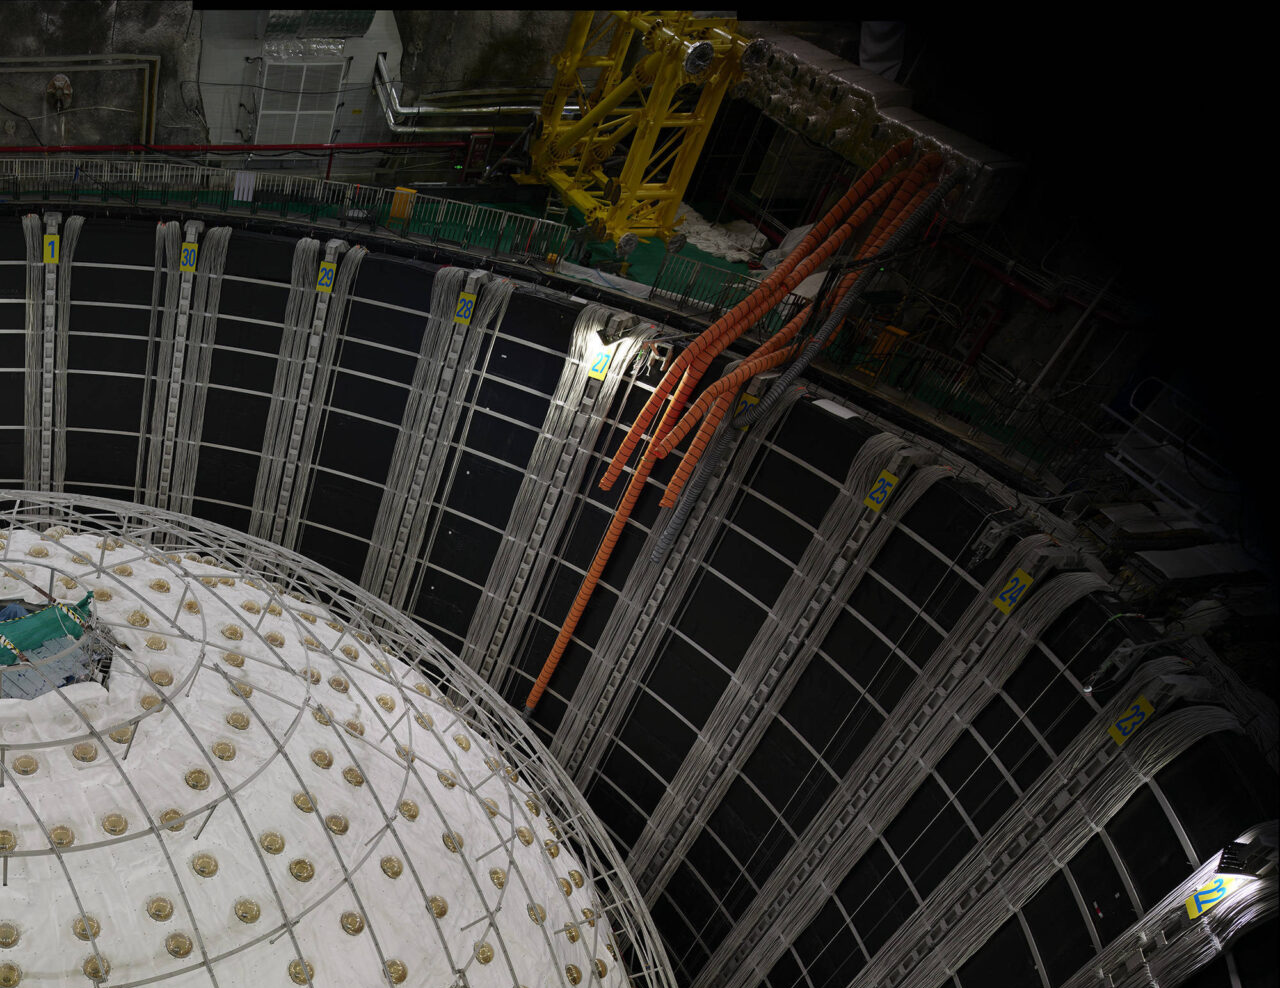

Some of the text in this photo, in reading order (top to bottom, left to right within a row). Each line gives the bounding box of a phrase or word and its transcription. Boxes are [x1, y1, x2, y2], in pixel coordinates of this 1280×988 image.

[48, 240, 55, 259] 1
[182, 248, 195, 266] 30
[318, 268, 333, 287] 29
[456, 299, 473, 319] 28
[592, 352, 611, 373] 27
[868, 478, 892, 505] 25
[999, 577, 1027, 607] 24
[1115, 705, 1145, 736] 23
[1194, 878, 1227, 913] 22
